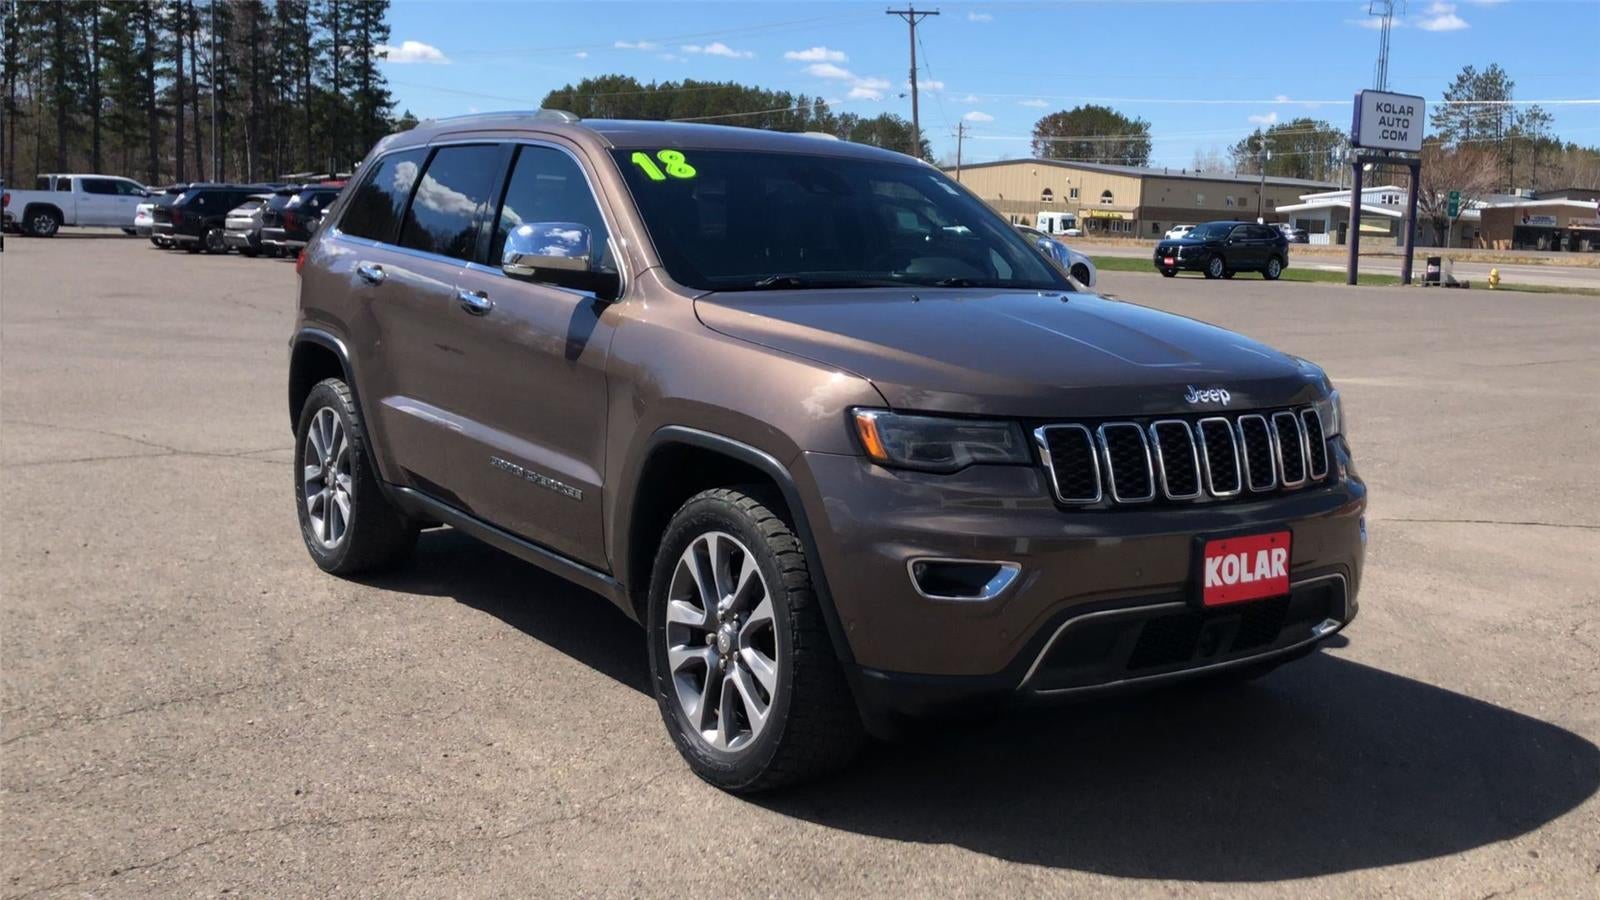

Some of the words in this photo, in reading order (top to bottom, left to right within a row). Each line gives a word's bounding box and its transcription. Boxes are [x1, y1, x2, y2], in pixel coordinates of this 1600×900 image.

[1376, 102, 1414, 116] KOLAR
[1378, 116, 1410, 129] AUTO
[1379, 129, 1408, 142] .COM
[631, 149, 697, 181] 18
[1184, 384, 1231, 406] Jeep
[1204, 547, 1288, 588] KOLAR
